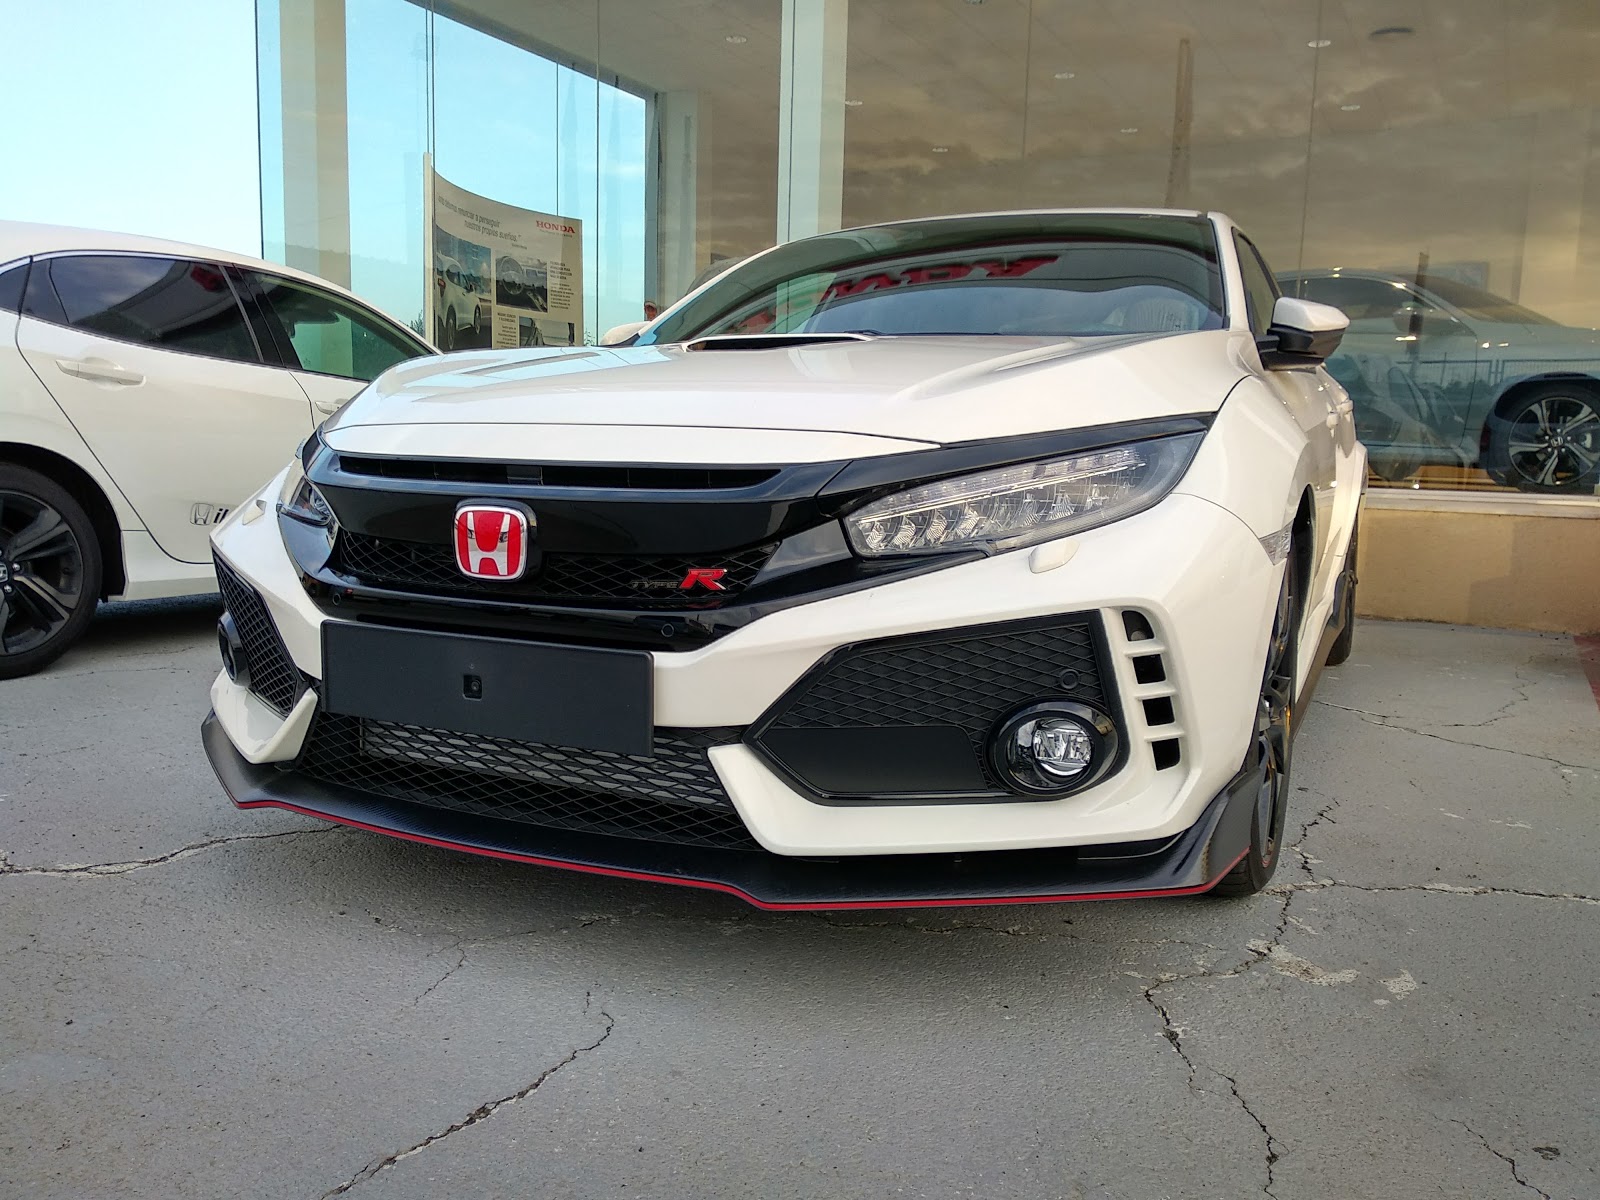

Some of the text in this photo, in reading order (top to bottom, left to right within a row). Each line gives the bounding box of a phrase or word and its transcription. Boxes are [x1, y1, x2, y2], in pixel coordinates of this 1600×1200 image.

[478, 215, 501, 228] perseguir
[535, 220, 576, 234] HONDA
[481, 226, 499, 238] propios
[630, 566, 728, 591] TYPE R
